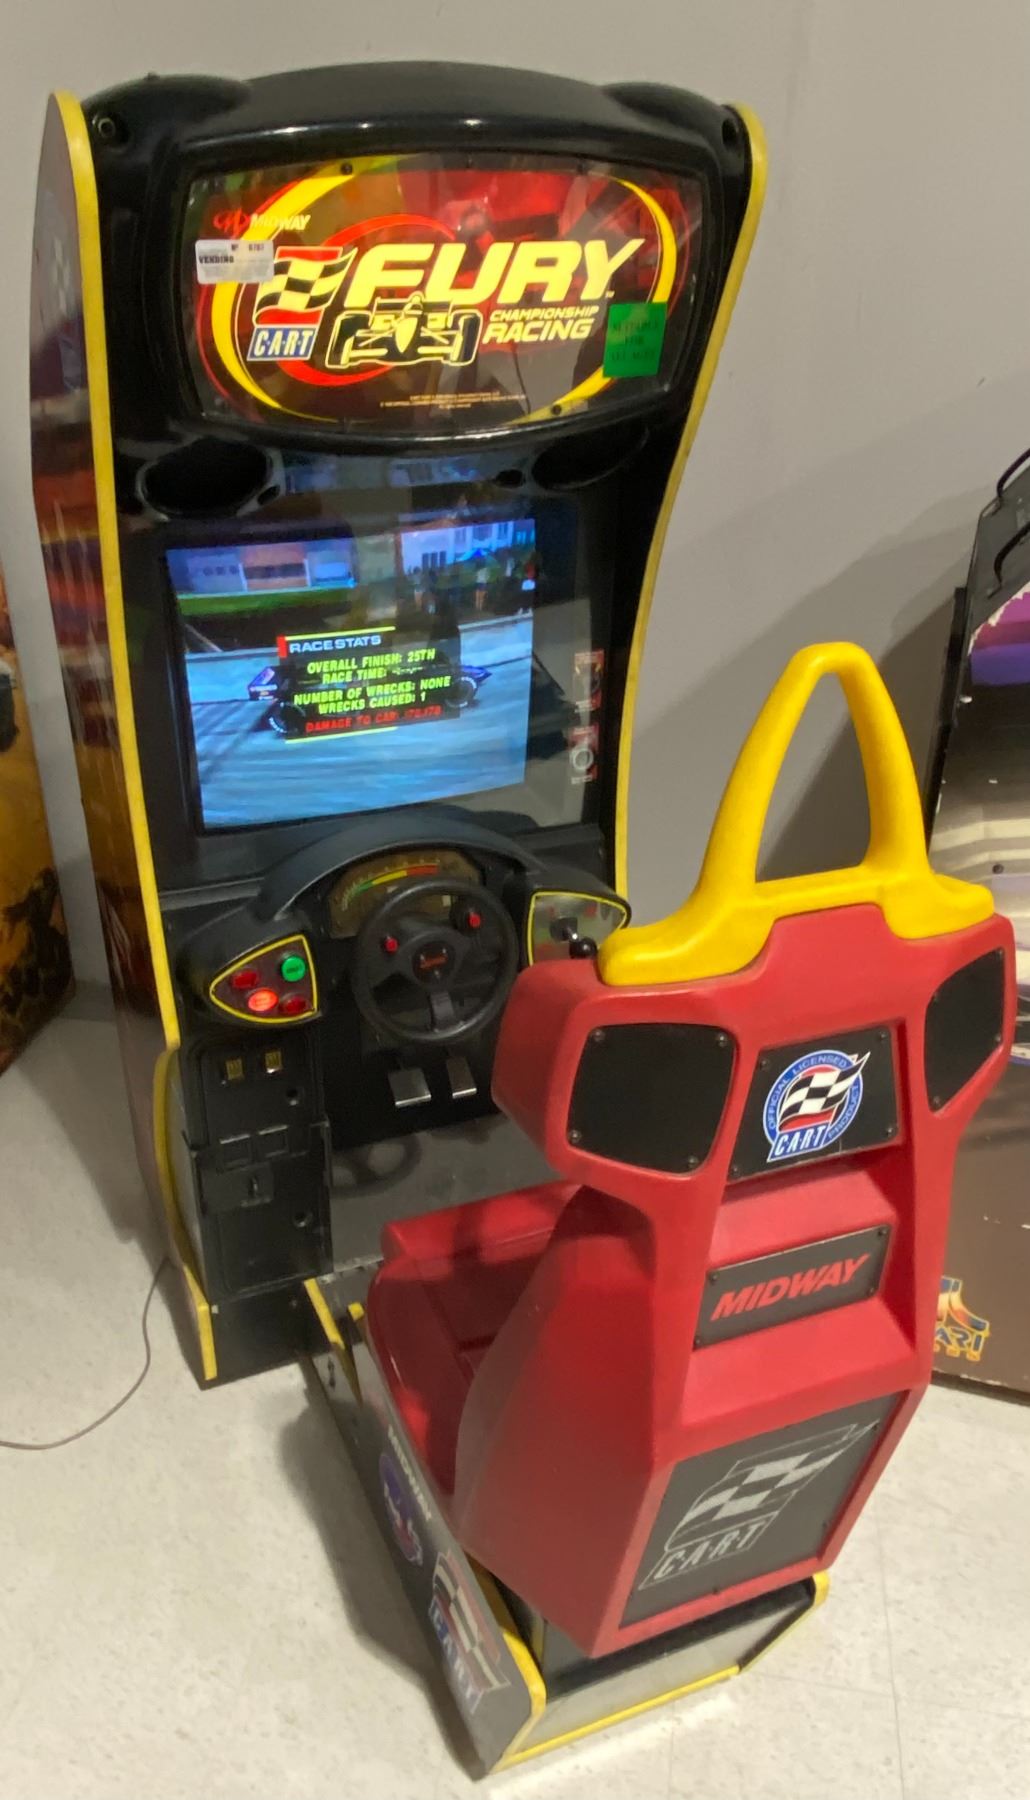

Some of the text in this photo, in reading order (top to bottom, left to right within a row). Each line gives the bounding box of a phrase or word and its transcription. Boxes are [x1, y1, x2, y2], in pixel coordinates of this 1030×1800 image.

[250, 213, 311, 231] MIDWAY
[199, 255, 234, 264] VENDING
[344, 238, 645, 308] FURY
[489, 305, 600, 322] CHAMPIONSHIP
[482, 318, 595, 344] RACING
[289, 635, 382, 654] RACE STATS
[307, 648, 436, 674] OVERALL FINISH: 25TH
[322, 671, 353, 685] RACE
[356, 668, 387, 682] TIME:
[294, 690, 343, 705] NUMBER
[347, 687, 362, 699] OF
[366, 680, 416, 697] WRECKS:
[420, 676, 452, 690] NONE
[318, 691, 426, 714] WRECKS CAUSED: 1
[305, 717, 351, 733] DAMAGE
[356, 714, 372, 726] TO
[767, 1054, 848, 1130] OFFICIAL LICENSED
[827, 1084, 859, 1139] PRODUCT
[709, 1252, 872, 1322] MIDWAY
